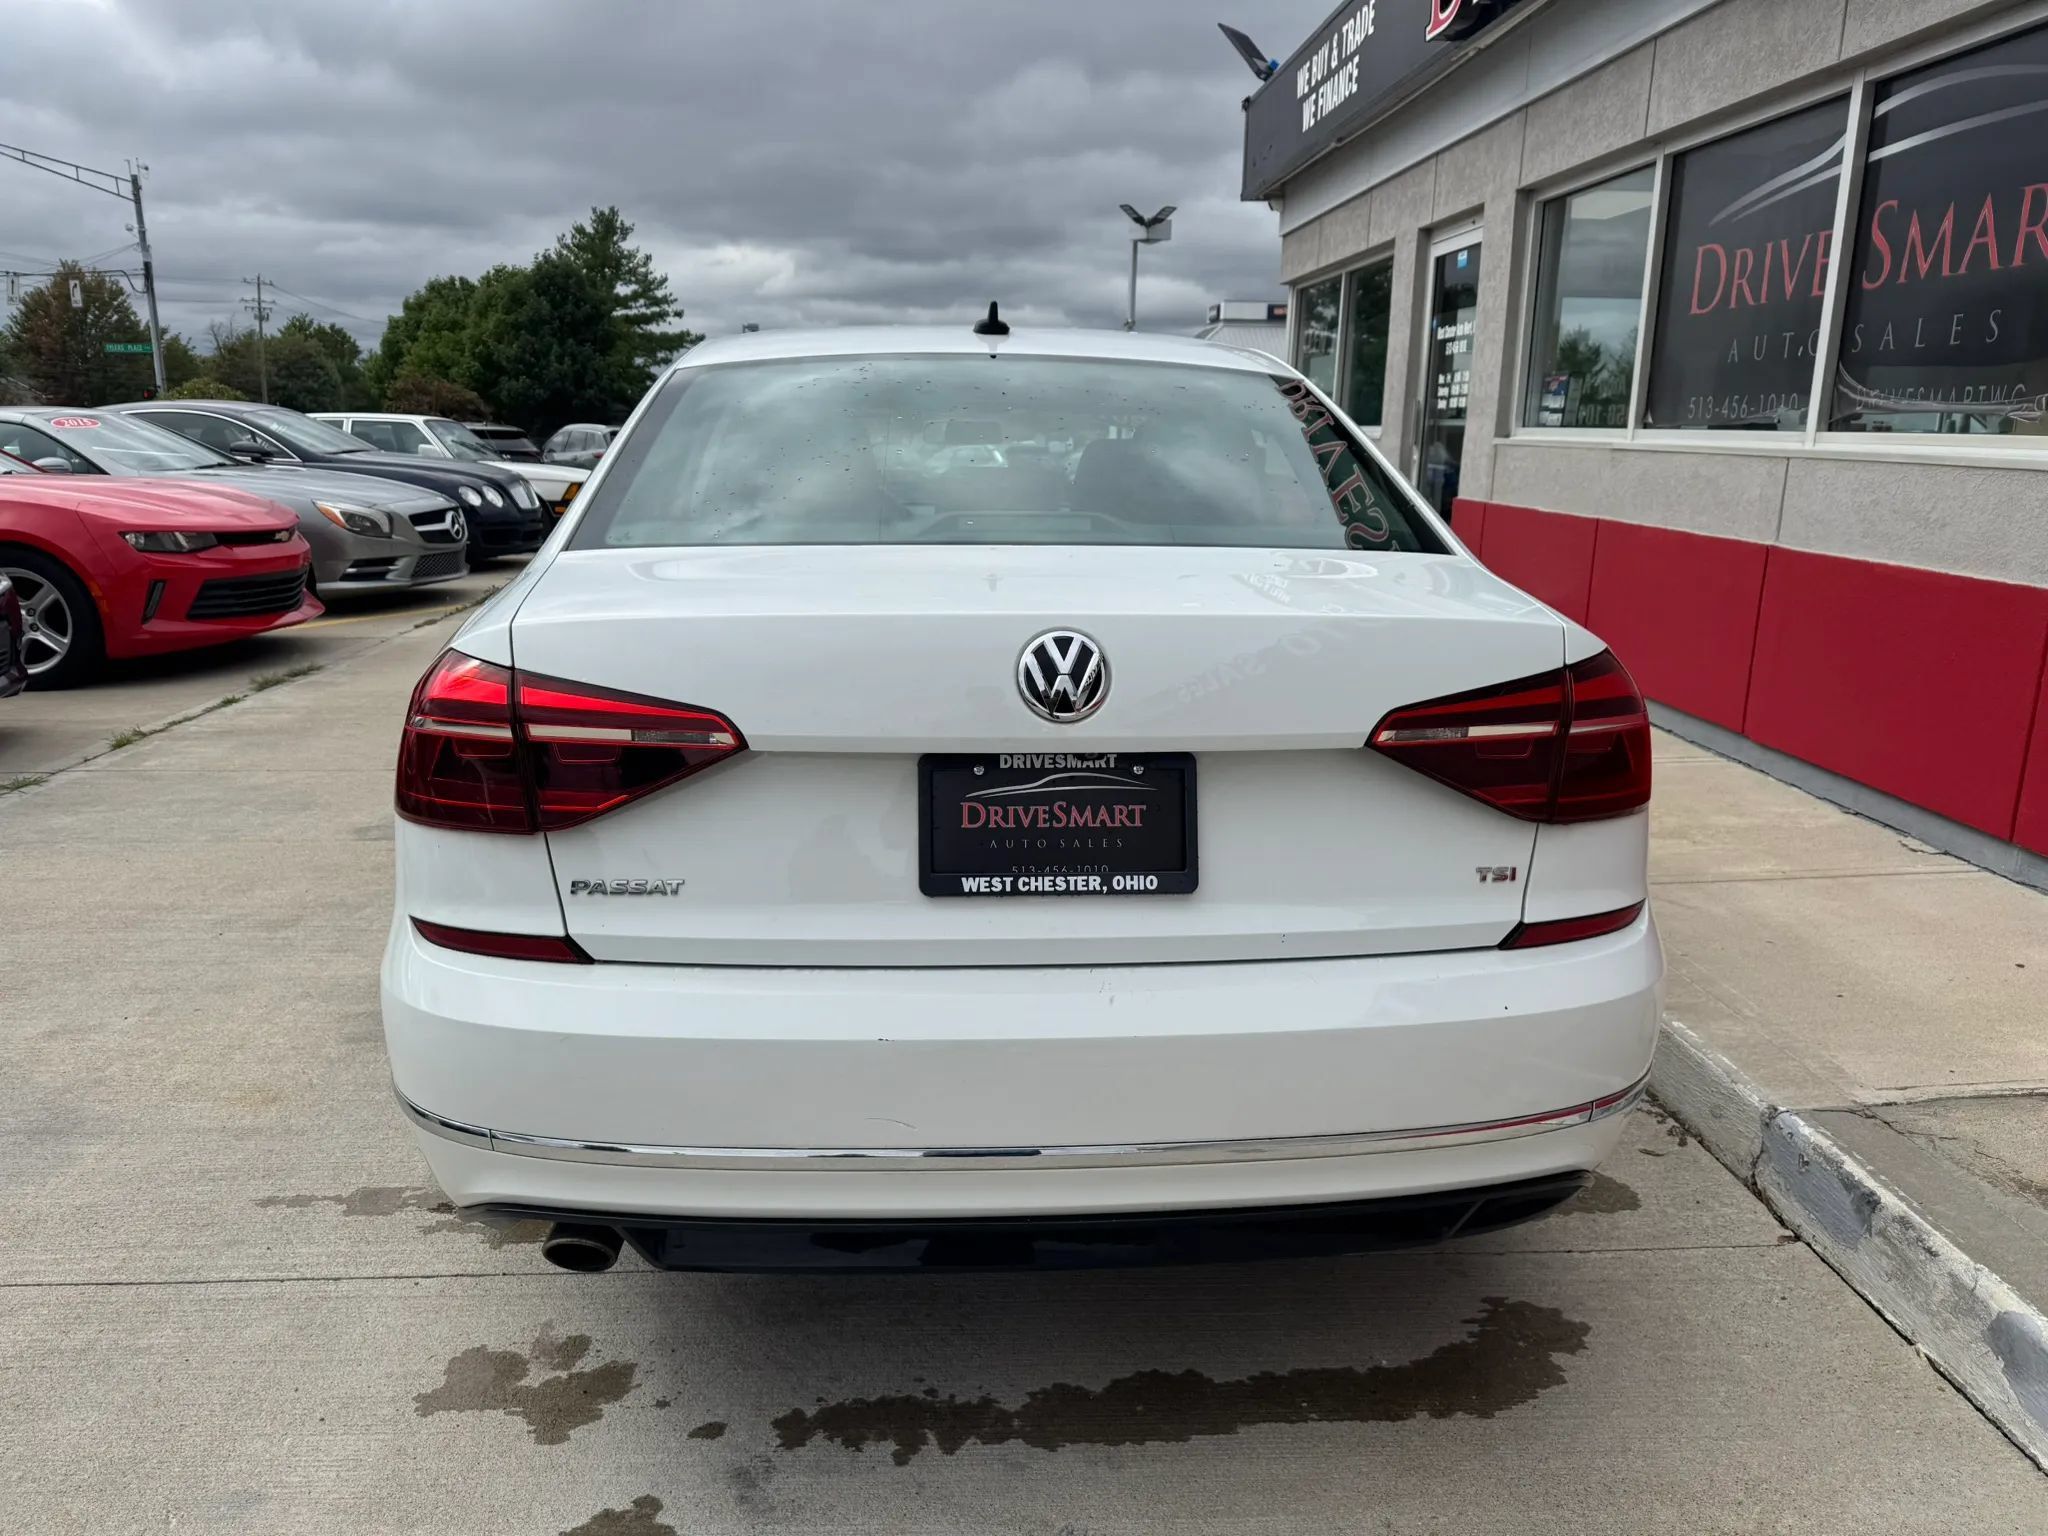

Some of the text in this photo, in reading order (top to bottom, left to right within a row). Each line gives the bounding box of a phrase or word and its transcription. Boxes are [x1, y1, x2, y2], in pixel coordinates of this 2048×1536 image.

[1297, 60, 1311, 99] WE
[1311, 40, 1330, 88] BUY
[1331, 32, 1338, 70] &
[1342, 0, 1376, 59] TRADE
[1302, 54, 1360, 134] WE FINANCE
[1852, 309, 2003, 354] SALES
[61, 418, 92, 427] 2015
[999, 754, 1118, 769] DRIVESMART
[989, 838, 1123, 849] AUTO SALES
[1475, 866, 1517, 882] TSI
[570, 879, 686, 897] PASSAT
[961, 875, 1159, 894] WEST CHESTER, OHIO
